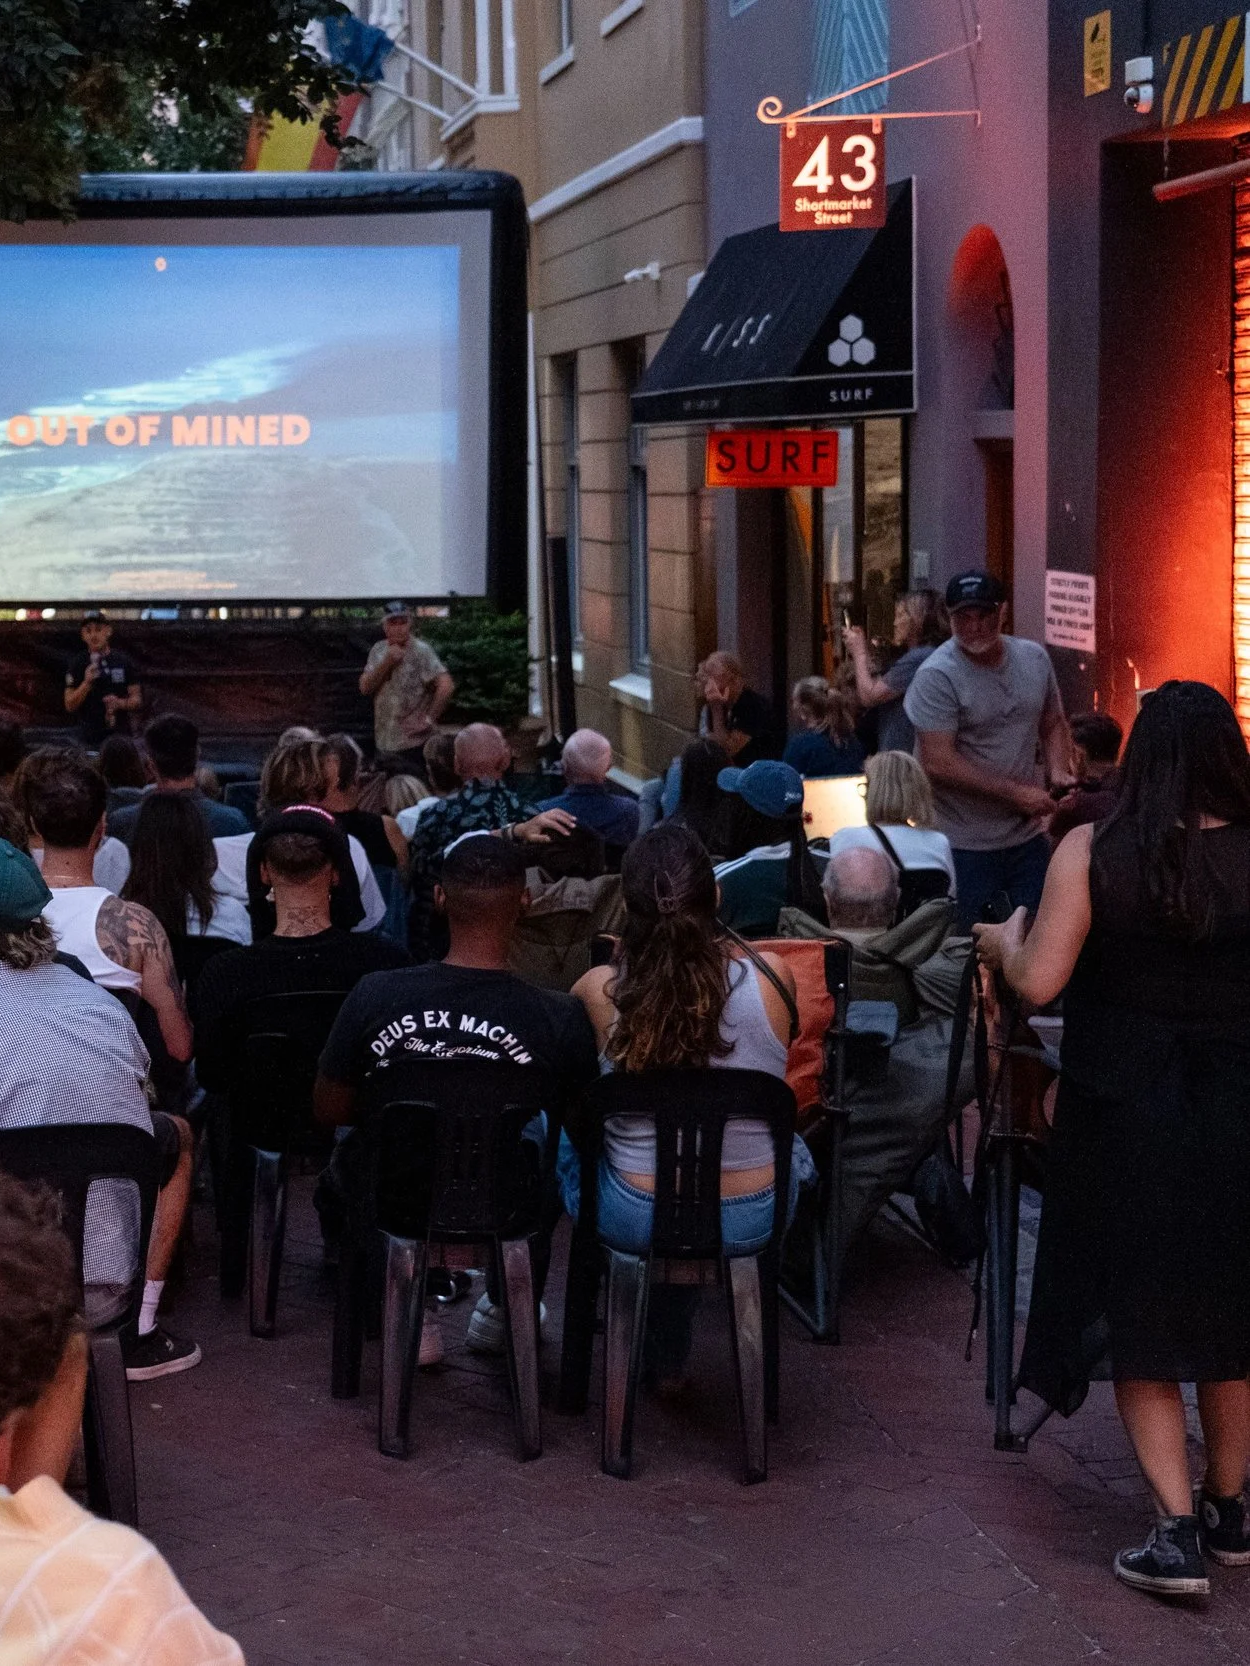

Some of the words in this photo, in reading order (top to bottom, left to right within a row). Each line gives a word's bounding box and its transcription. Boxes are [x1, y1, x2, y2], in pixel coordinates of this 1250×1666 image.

[792, 133, 877, 193] 43
[794, 195, 873, 212] Shortmarket
[814, 210, 854, 225] Street
[829, 388, 874, 403] SURF
[6, 414, 94, 447] OUT
[105, 414, 160, 447] OF
[172, 413, 311, 447] MINED
[716, 439, 831, 474] SURF
[371, 1014, 418, 1057] DEUS
[423, 1010, 451, 1029] EX
[458, 1013, 533, 1066] MACHIN
[403, 1037, 431, 1053] The
